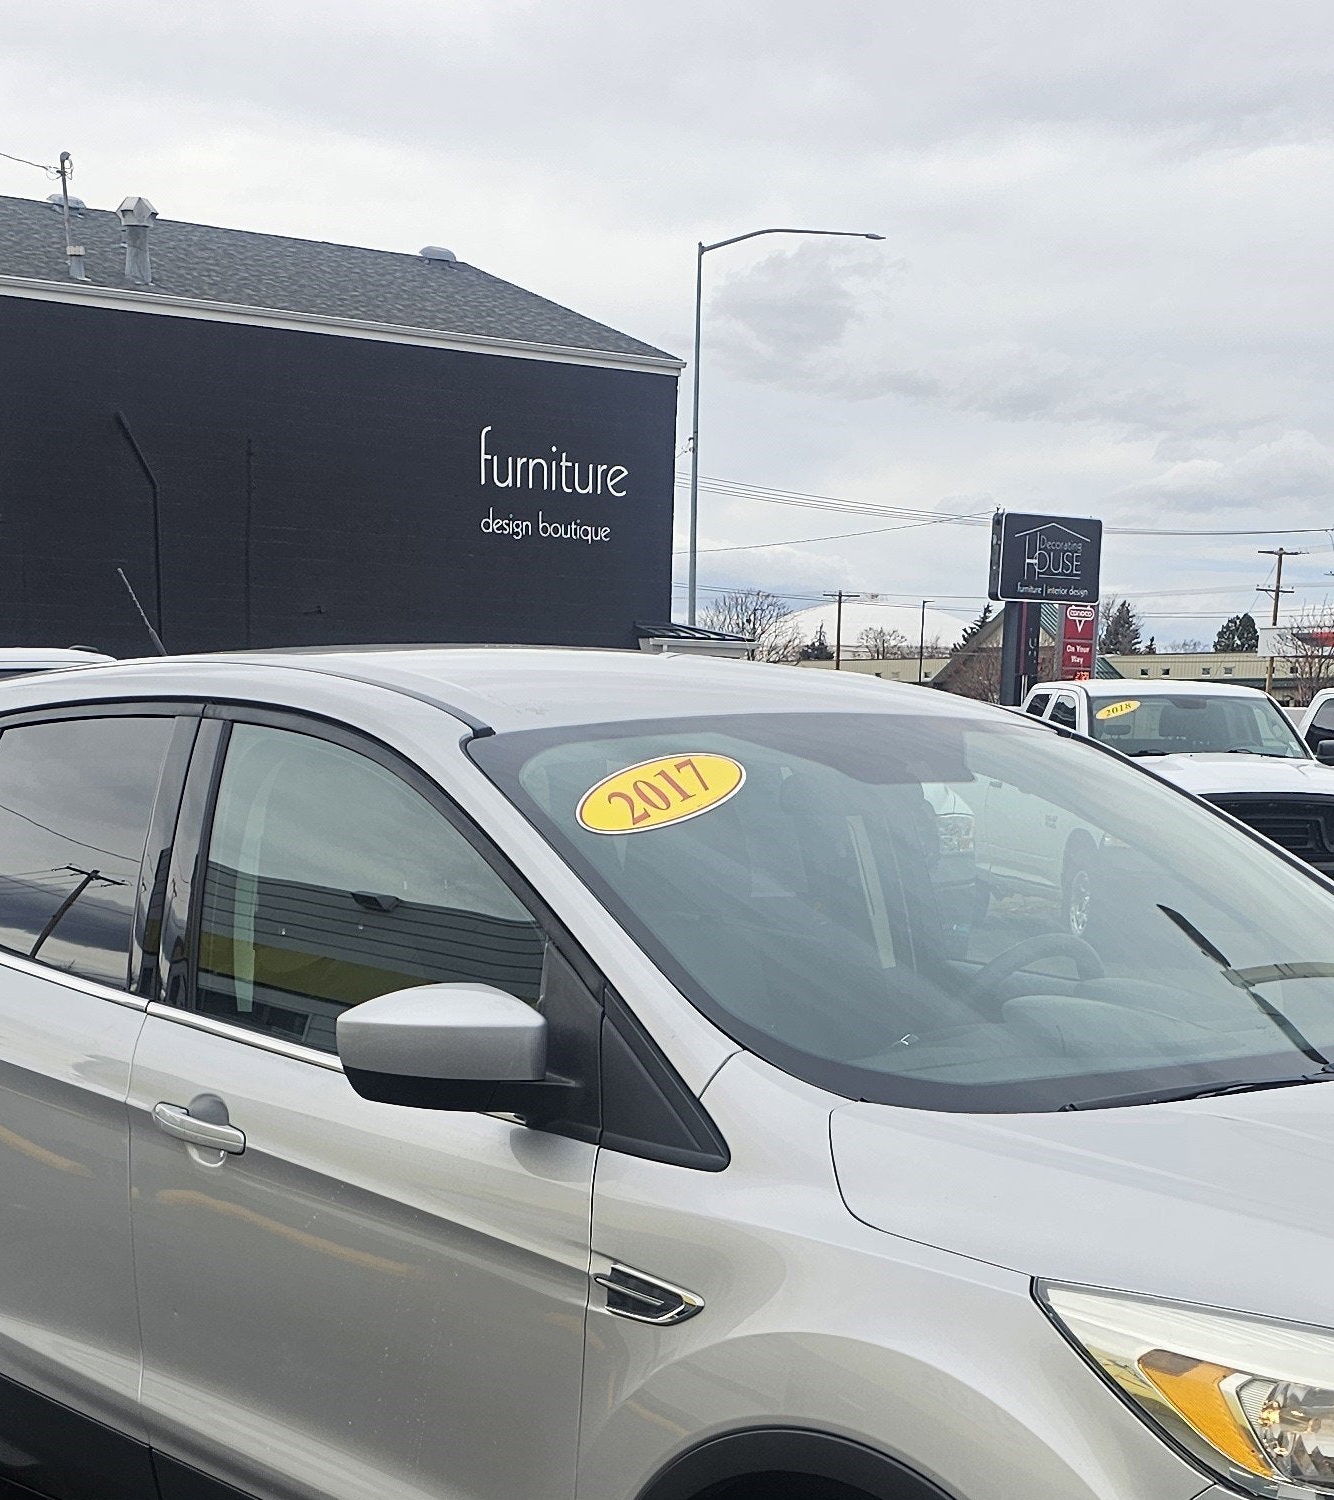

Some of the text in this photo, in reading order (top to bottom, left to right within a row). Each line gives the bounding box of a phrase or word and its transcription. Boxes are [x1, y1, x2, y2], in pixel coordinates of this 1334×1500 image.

[480, 425, 629, 497] furniture
[480, 507, 611, 544] design boutique
[1040, 535, 1082, 552] Decorating
[1024, 532, 1081, 580] HOUSE
[1017, 582, 1088, 597] furniture interior design
[1067, 644, 1090, 653] On Your
[1070, 656, 1084, 665] Way
[1107, 702, 1132, 716] 2018
[607, 758, 710, 826] 2017
